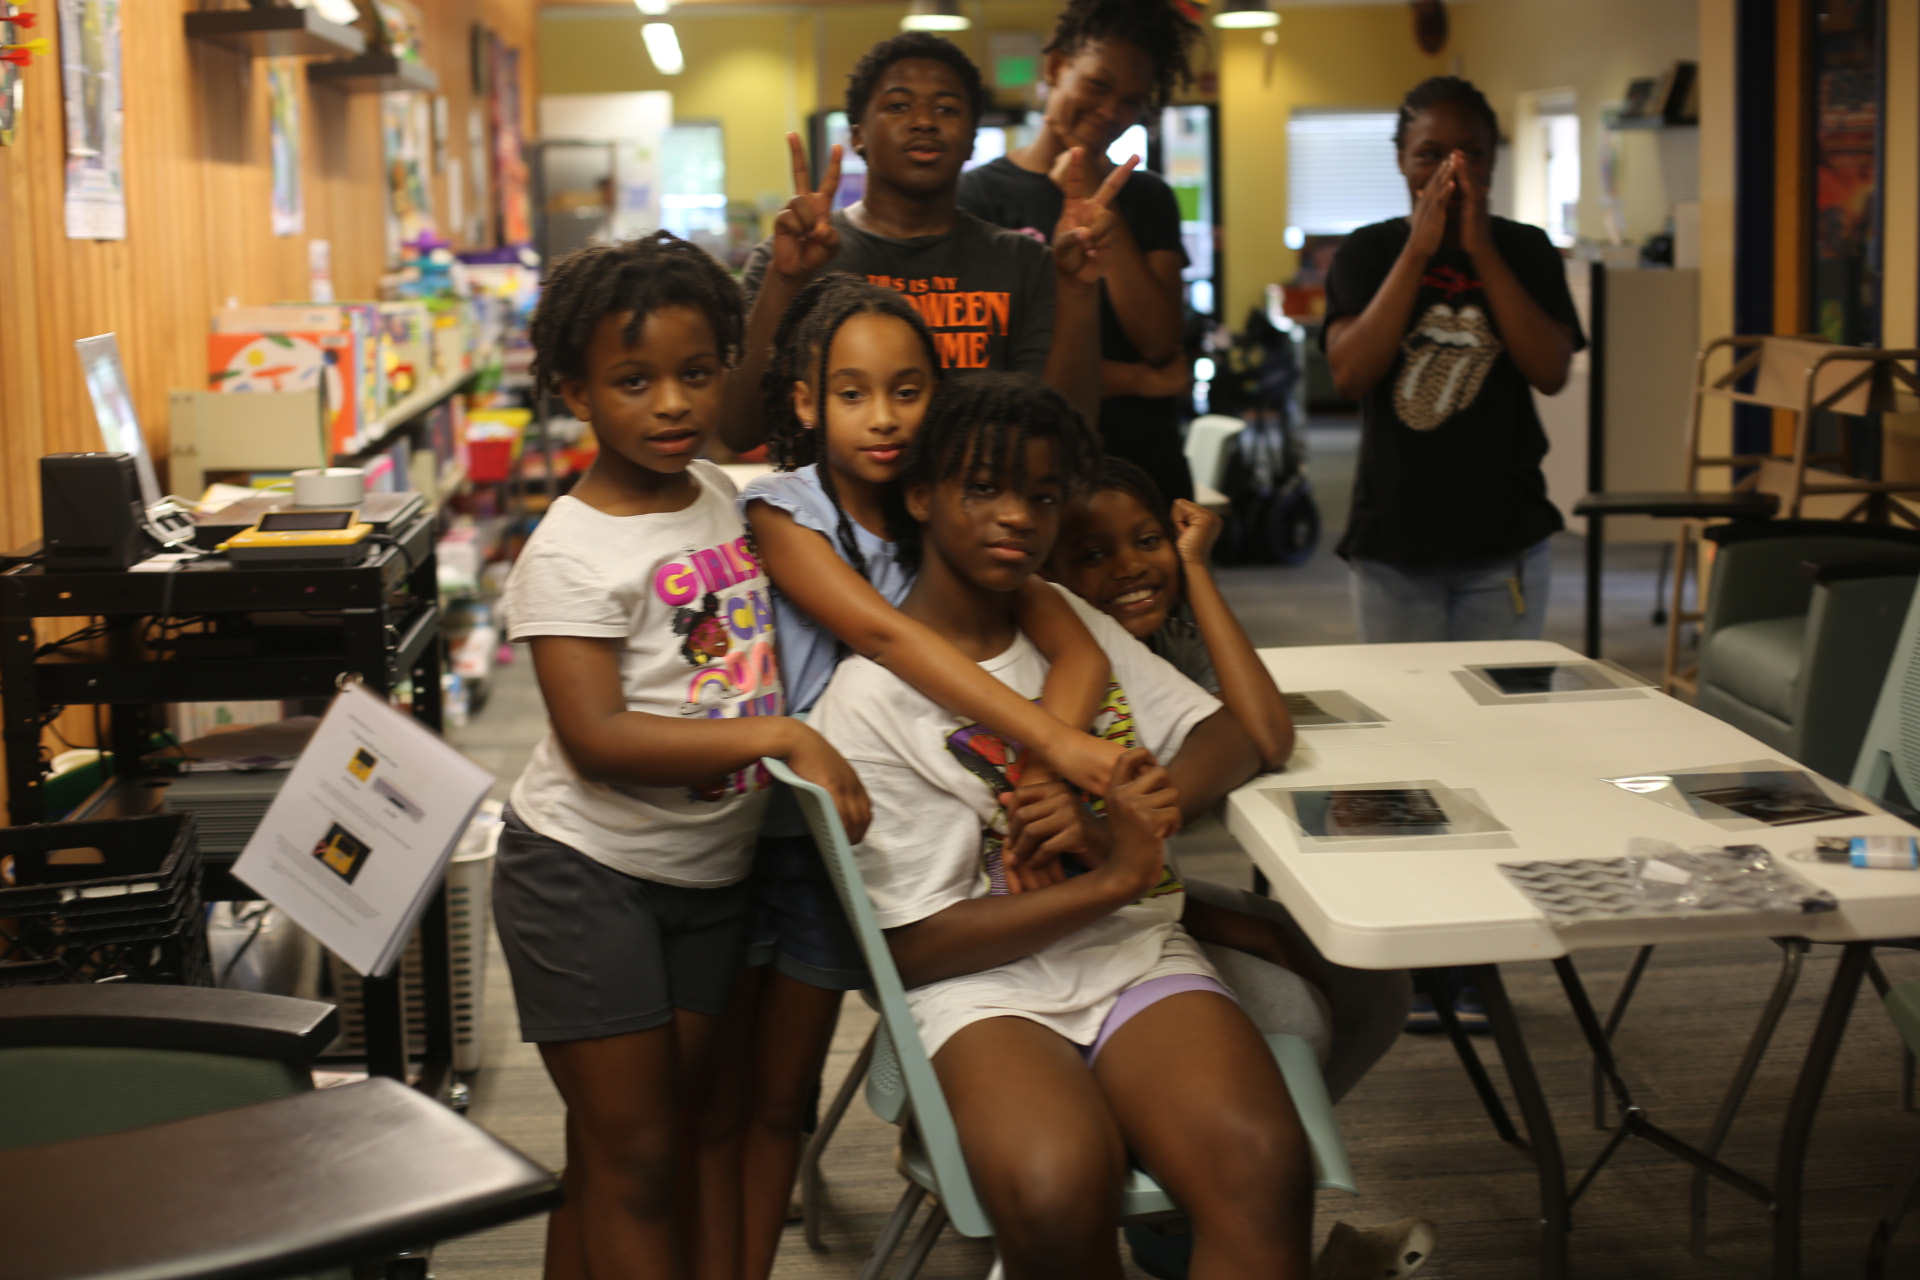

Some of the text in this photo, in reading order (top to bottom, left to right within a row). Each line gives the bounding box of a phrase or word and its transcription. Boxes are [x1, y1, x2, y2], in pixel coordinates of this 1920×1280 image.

[909, 279, 929, 293] IS
[931, 276, 958, 290] MY
[933, 332, 991, 369] ME
